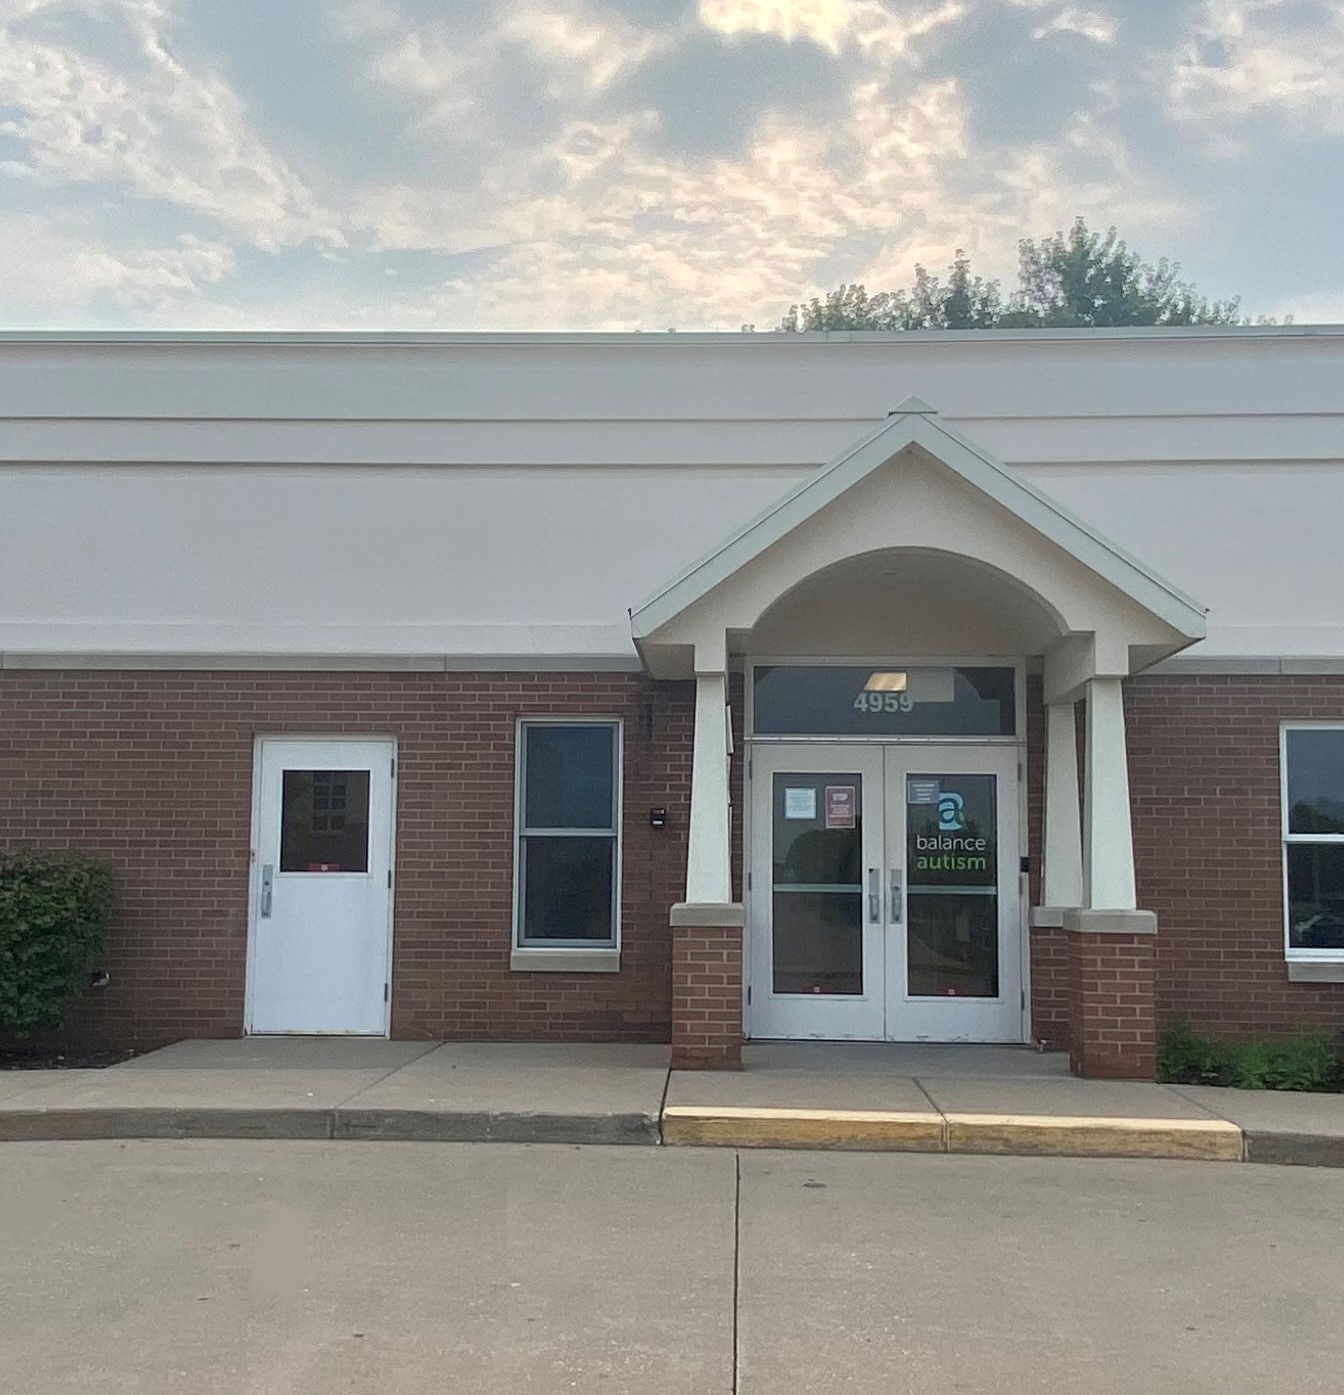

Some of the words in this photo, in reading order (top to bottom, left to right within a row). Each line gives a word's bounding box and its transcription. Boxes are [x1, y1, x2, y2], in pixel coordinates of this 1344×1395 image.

[853, 692, 913, 713] 4959
[916, 834, 986, 851] balance
[917, 853, 986, 870] autism
